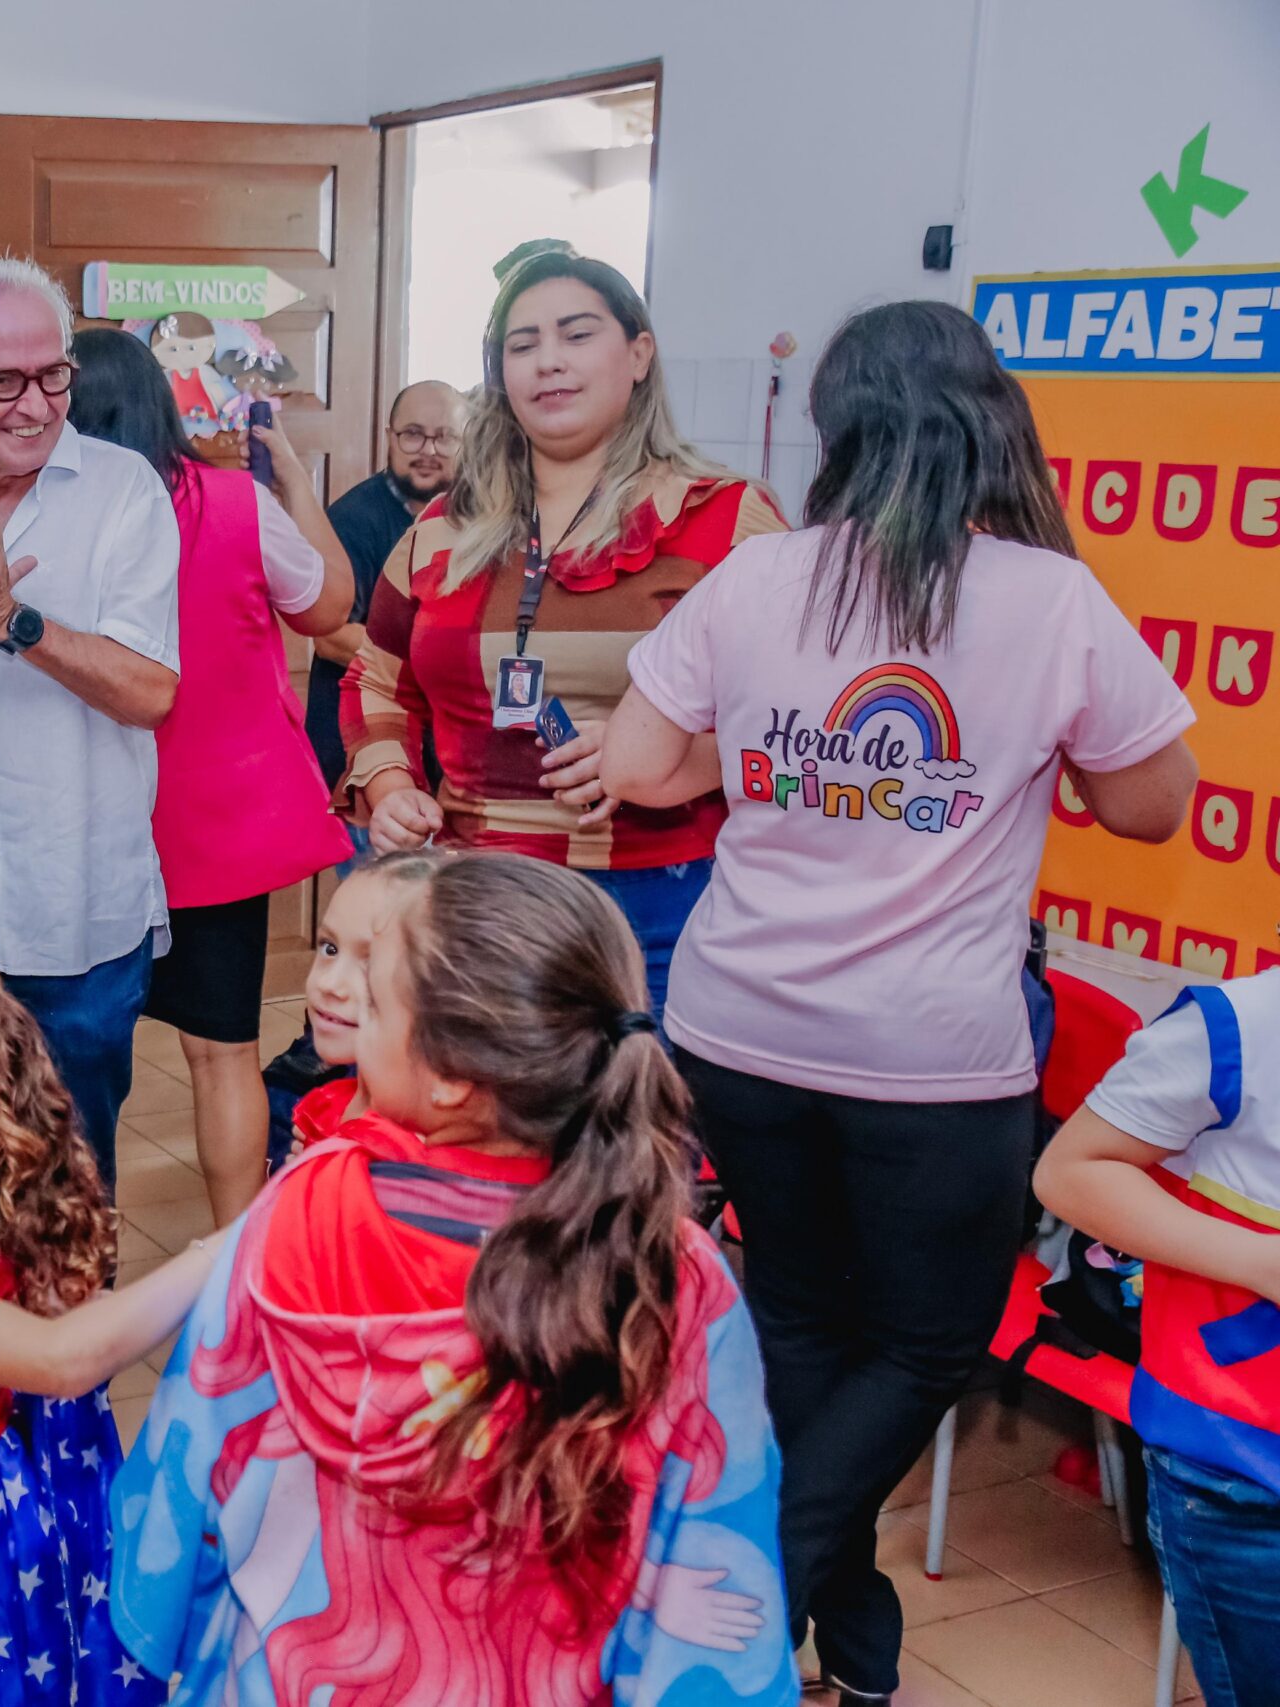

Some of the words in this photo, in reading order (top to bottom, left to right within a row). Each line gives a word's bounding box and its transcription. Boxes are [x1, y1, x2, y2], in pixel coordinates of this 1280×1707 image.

[107, 279, 268, 305] BEM-VINDOS
[983, 286, 1280, 361] ALFABE
[1091, 471, 1128, 524] C
[1163, 474, 1202, 529] D
[1241, 478, 1280, 537] E
[1216, 635, 1258, 695] K
[763, 707, 855, 767] Hora
[862, 723, 909, 771] de
[1201, 794, 1239, 852] Q
